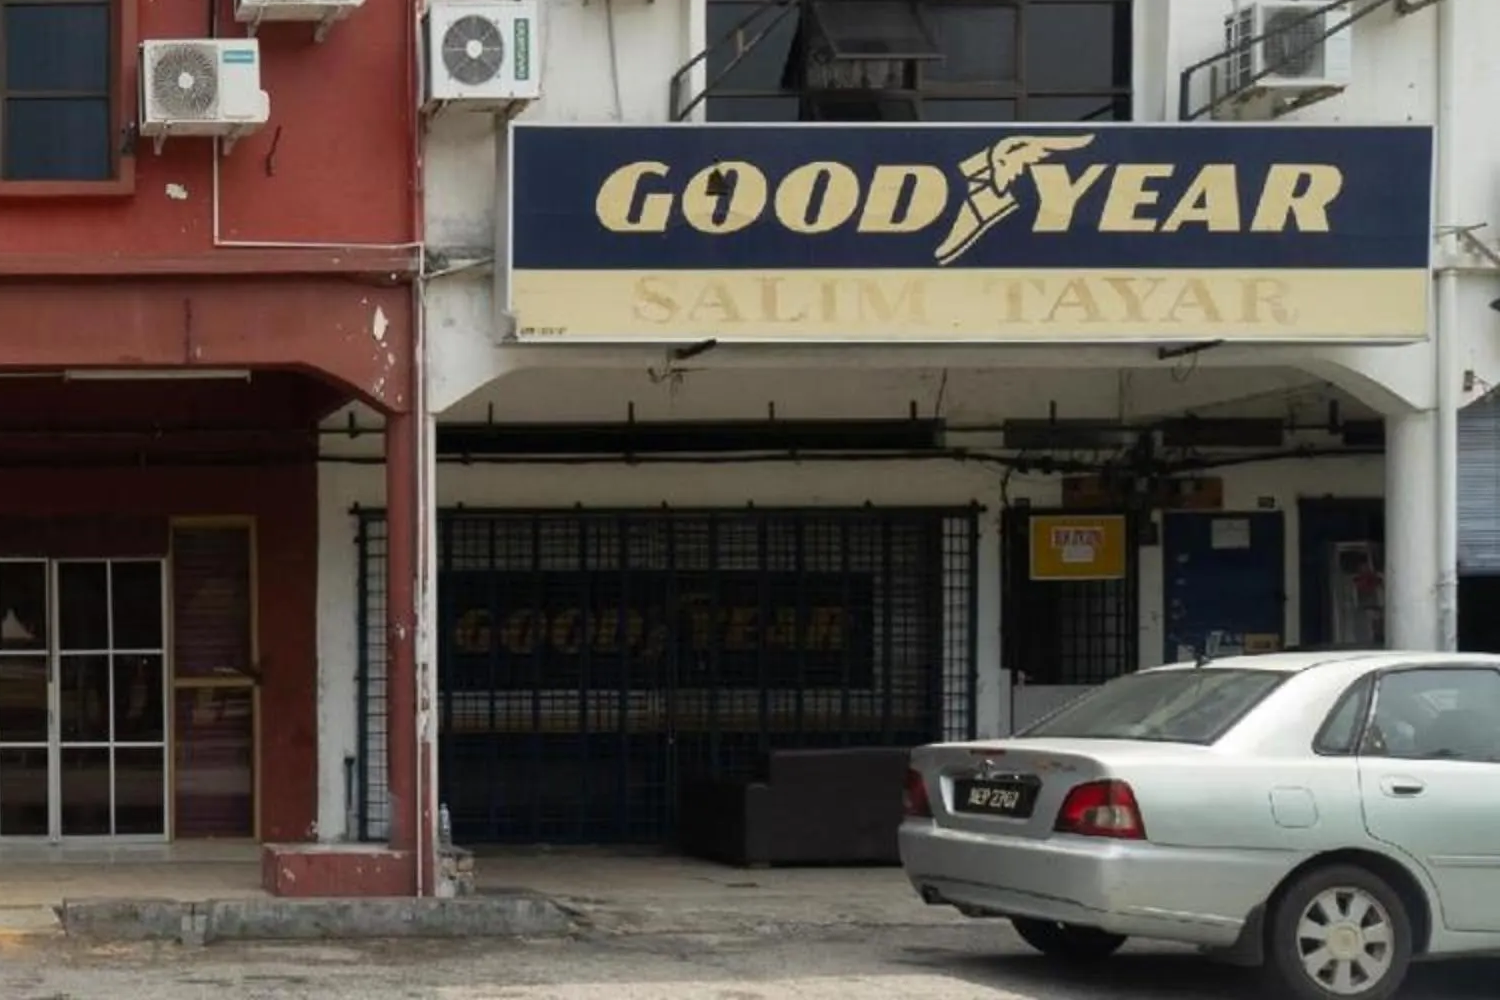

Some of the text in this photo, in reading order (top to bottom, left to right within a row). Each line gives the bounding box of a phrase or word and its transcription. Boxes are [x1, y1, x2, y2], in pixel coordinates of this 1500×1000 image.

[595, 161, 1344, 234] GOOD YEAR
[630, 276, 1300, 326] SALIM TAYAR
